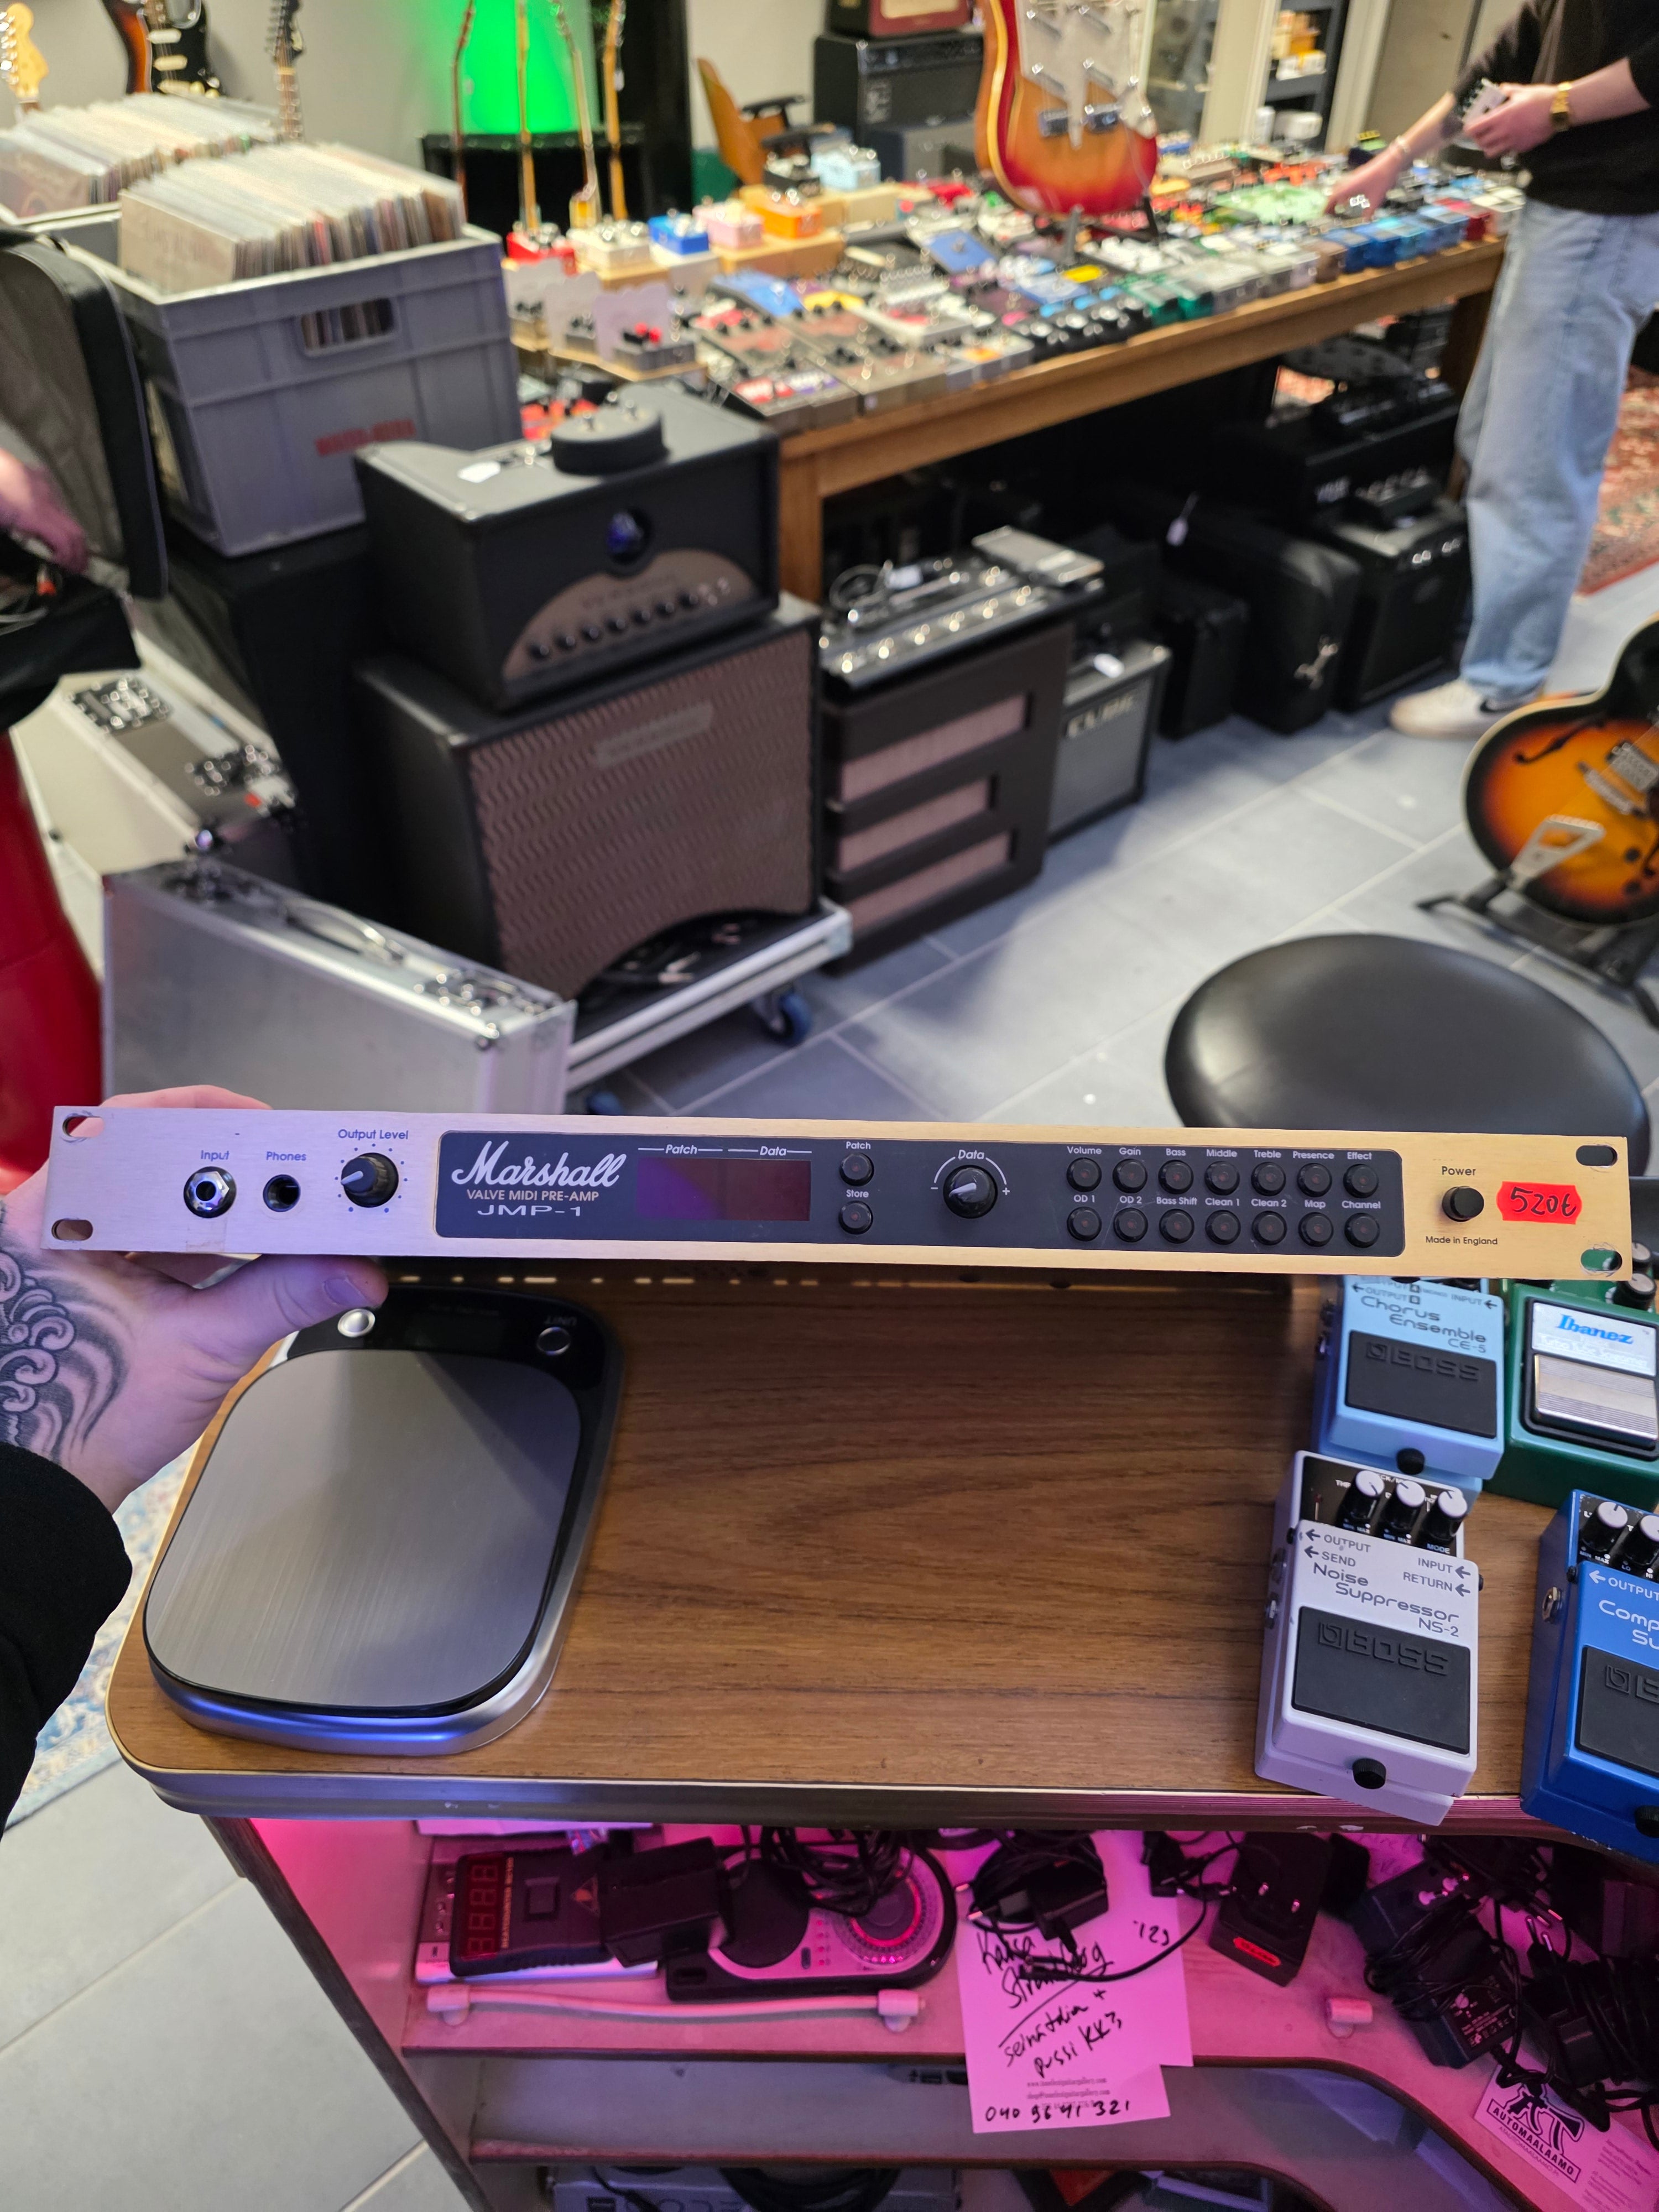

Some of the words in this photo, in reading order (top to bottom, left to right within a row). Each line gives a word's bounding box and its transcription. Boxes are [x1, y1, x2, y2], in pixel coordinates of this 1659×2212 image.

[338, 1129, 377, 1141] Output
[379, 1129, 409, 1140] Level
[665, 1144, 697, 1155] Patch
[759, 1146, 787, 1156] Data
[846, 1141, 871, 1150] Patch
[1067, 1146, 1102, 1155] Volume
[1119, 1147, 1141, 1155] Gain
[201, 1150, 229, 1161] Input
[266, 1151, 307, 1162] Phones
[958, 1149, 985, 1160] Data
[1166, 1148, 1186, 1156] Bass
[1206, 1149, 1238, 1157] Middle
[1254, 1150, 1282, 1158] Treble
[1292, 1151, 1334, 1160] Presence
[1347, 1152, 1372, 1160] Effect
[451, 1140, 627, 1187] Marshall
[1442, 1166, 1476, 1176] Power
[467, 1189, 505, 1201] VALVE
[509, 1190, 537, 1201] MIDI
[541, 1191, 599, 1202] PRE-AMP
[846, 1190, 869, 1198] Store
[1073, 1194, 1089, 1203] OD
[1119, 1196, 1134, 1204] OD
[1136, 1196, 1142, 1204] 2
[1156, 1197, 1176, 1205] Bass
[1178, 1197, 1197, 1205] Shift
[1205, 1197, 1233, 1206] Clean
[1251, 1198, 1279, 1207] Clean
[1281, 1199, 1287, 1207] 2
[1305, 1199, 1326, 1209] Map
[1342, 1201, 1381, 1209] Channel
[477, 1204, 581, 1217] JMP-1
[1463, 1237, 1498, 1246] England
[1365, 1286, 1407, 1301] OUTPUT
[1451, 1294, 1482, 1306] INPUT
[1360, 1296, 1440, 1321] Chorus
[1389, 1313, 1486, 1343] Ensemble
[1557, 1313, 1634, 1344] Ibanez
[1448, 1338, 1486, 1354] CE-5
[1390, 1347, 1480, 1382] BOSS
[1324, 1535, 1371, 1553] OUTPUT
[1427, 1543, 1451, 1554] MODE
[1322, 1551, 1356, 1567] SEND
[1418, 1557, 1453, 1574] INPUT
[1313, 1562, 1369, 1587] Noise
[1403, 1572, 1453, 1592] RETURN
[1335, 1582, 1459, 1623] Suppressor
[1418, 1618, 1459, 1637] NS-2
[1345, 1629, 1449, 1676] BOSS
[986, 2105, 1020, 2122] 040
[1493, 2106, 1574, 2175] AUTOMAALAAMO
